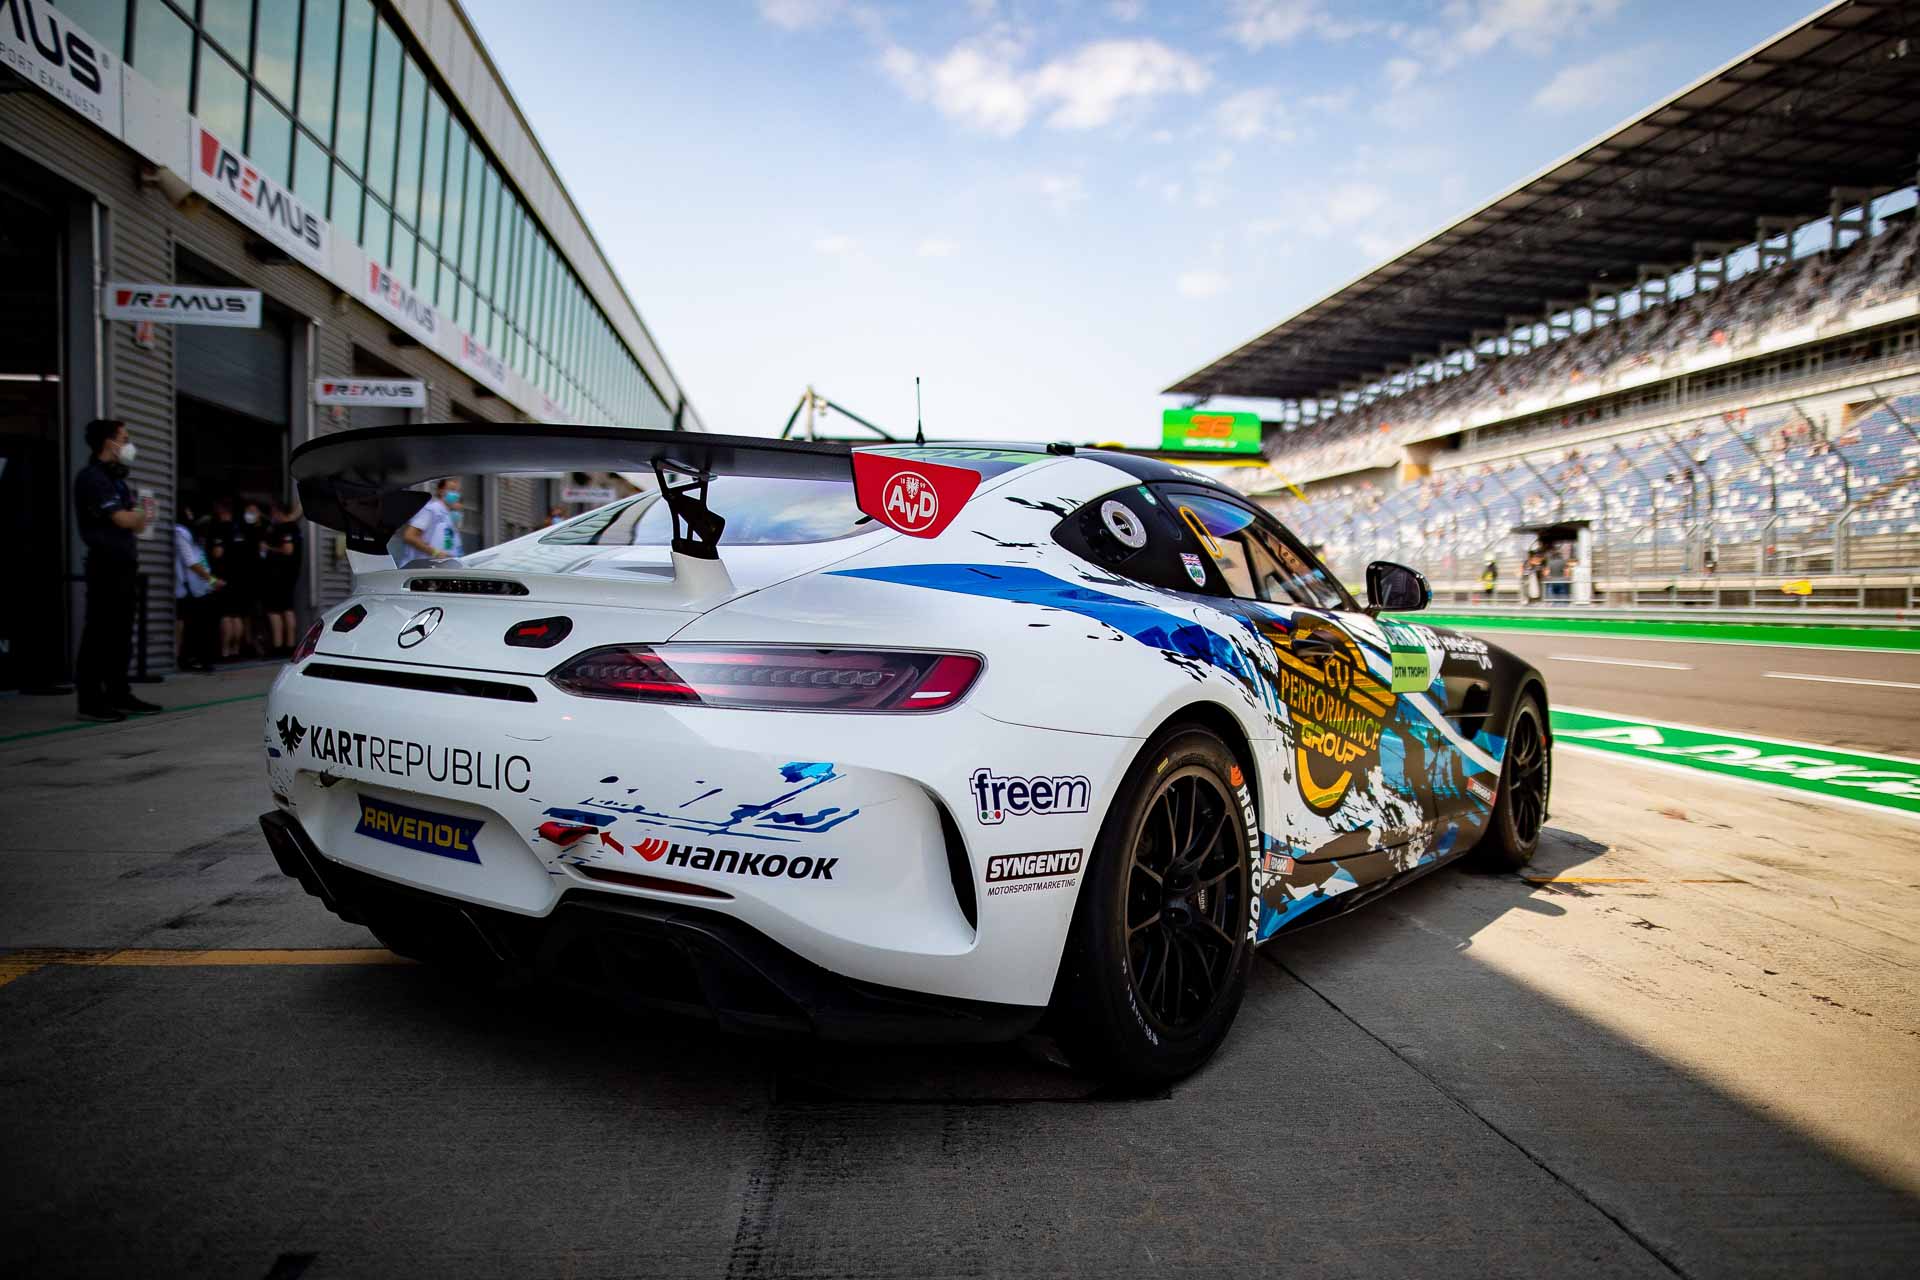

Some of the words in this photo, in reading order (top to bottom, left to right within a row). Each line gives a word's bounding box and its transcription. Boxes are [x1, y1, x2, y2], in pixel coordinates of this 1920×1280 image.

[217, 149, 321, 249] REMUS
[131, 292, 247, 313] REMUS
[332, 383, 415, 398] REMUS
[1395, 666, 1407, 679] DTM
[1408, 666, 1428, 678] TROPHY
[1281, 668, 1382, 751] PERFORMANCE
[1301, 722, 1357, 764] GROUP
[974, 773, 1088, 811] freem
[364, 807, 470, 851] RAVENOL
[988, 852, 1081, 880] SYNGENTO
[987, 878, 1076, 896] MOTORSPORTMARKETING
